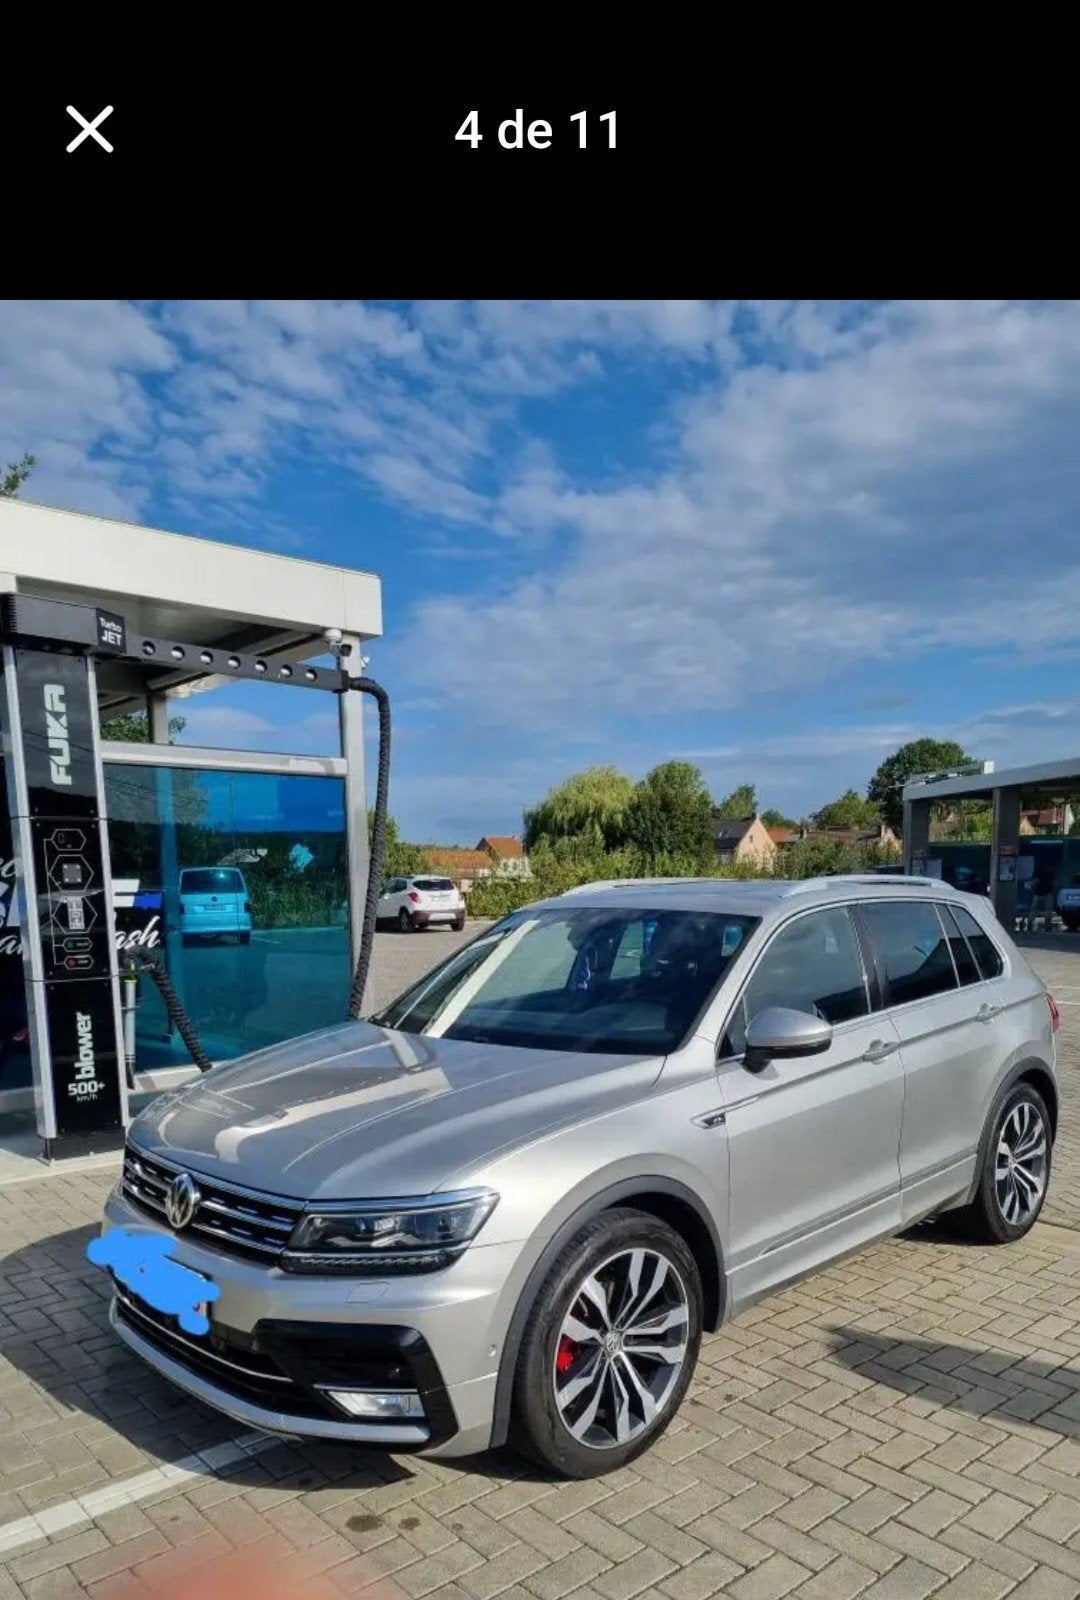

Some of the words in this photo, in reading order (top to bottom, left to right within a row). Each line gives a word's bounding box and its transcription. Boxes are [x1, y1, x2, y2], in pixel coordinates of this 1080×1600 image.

[101, 630, 122, 646] JET
[44, 684, 72, 785] FUKA
[74, 1011, 95, 1080] blower
